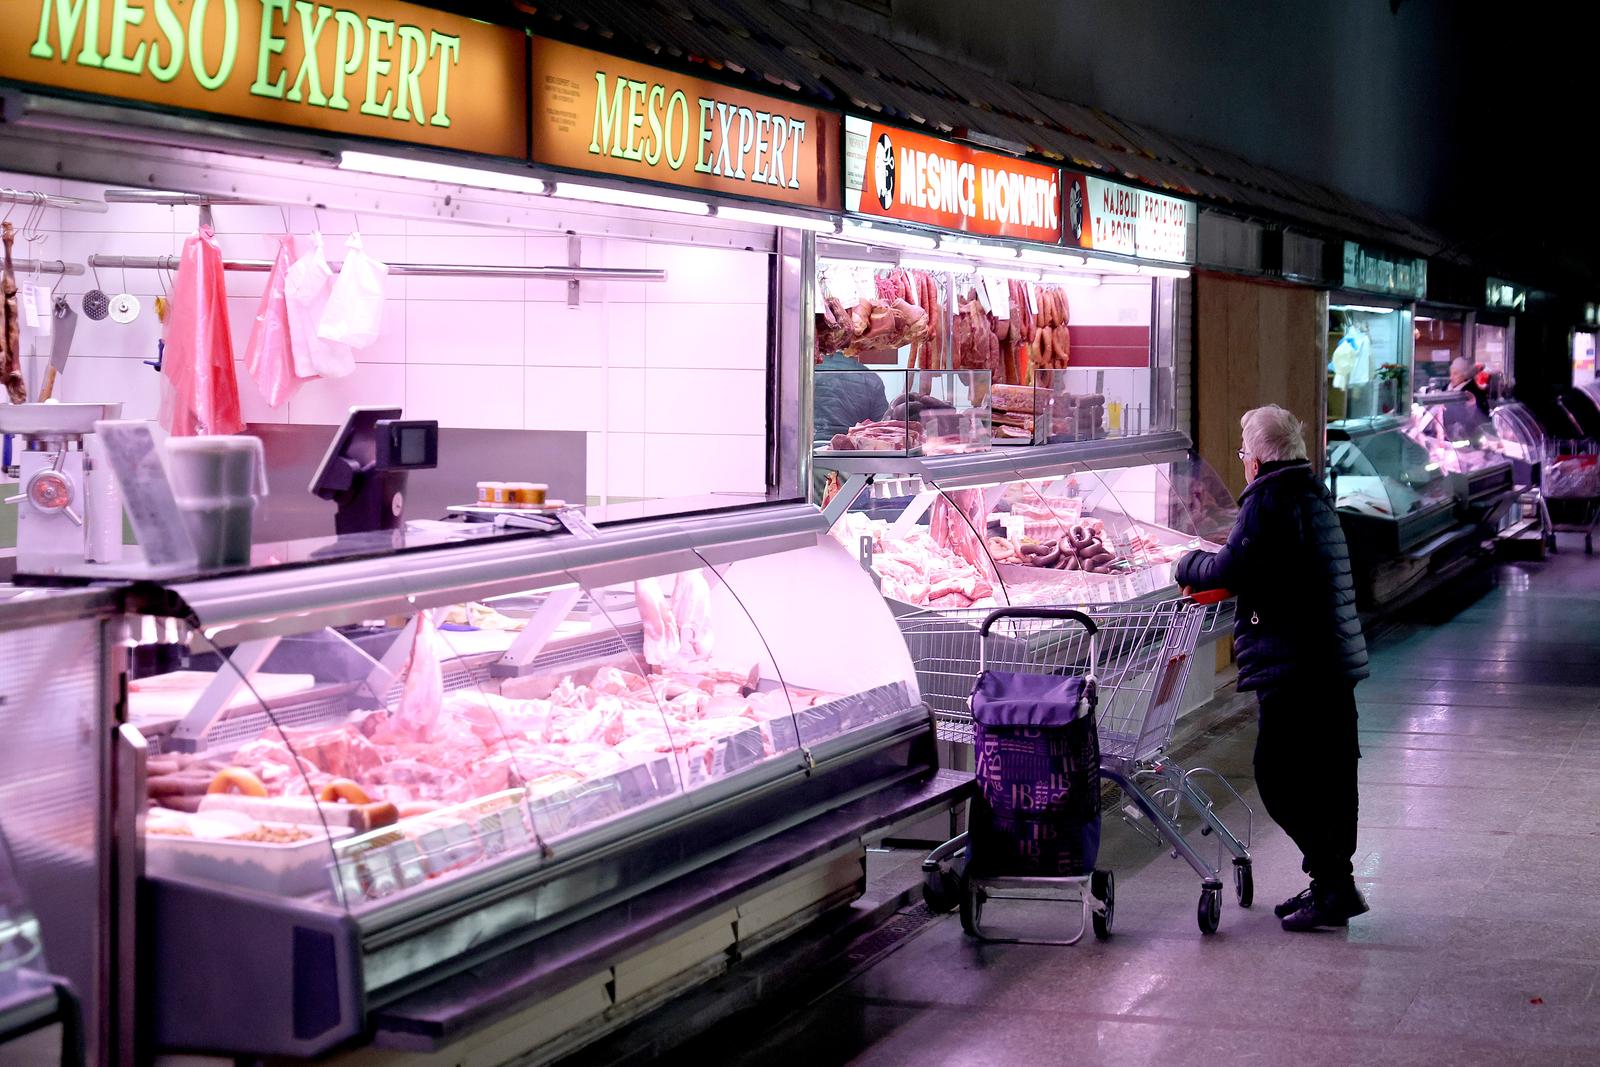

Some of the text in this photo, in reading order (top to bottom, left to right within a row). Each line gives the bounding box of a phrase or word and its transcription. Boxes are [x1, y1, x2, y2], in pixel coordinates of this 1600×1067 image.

[30, 0, 461, 128] MESO EXPERT
[588, 71, 690, 171] MESO
[694, 97, 806, 189] EXPERT
[900, 146, 977, 218] MESNICE
[980, 172, 1058, 231] HORVATIĆ
[1103, 187, 1187, 228] NAJBOLJI PROIZVODI
